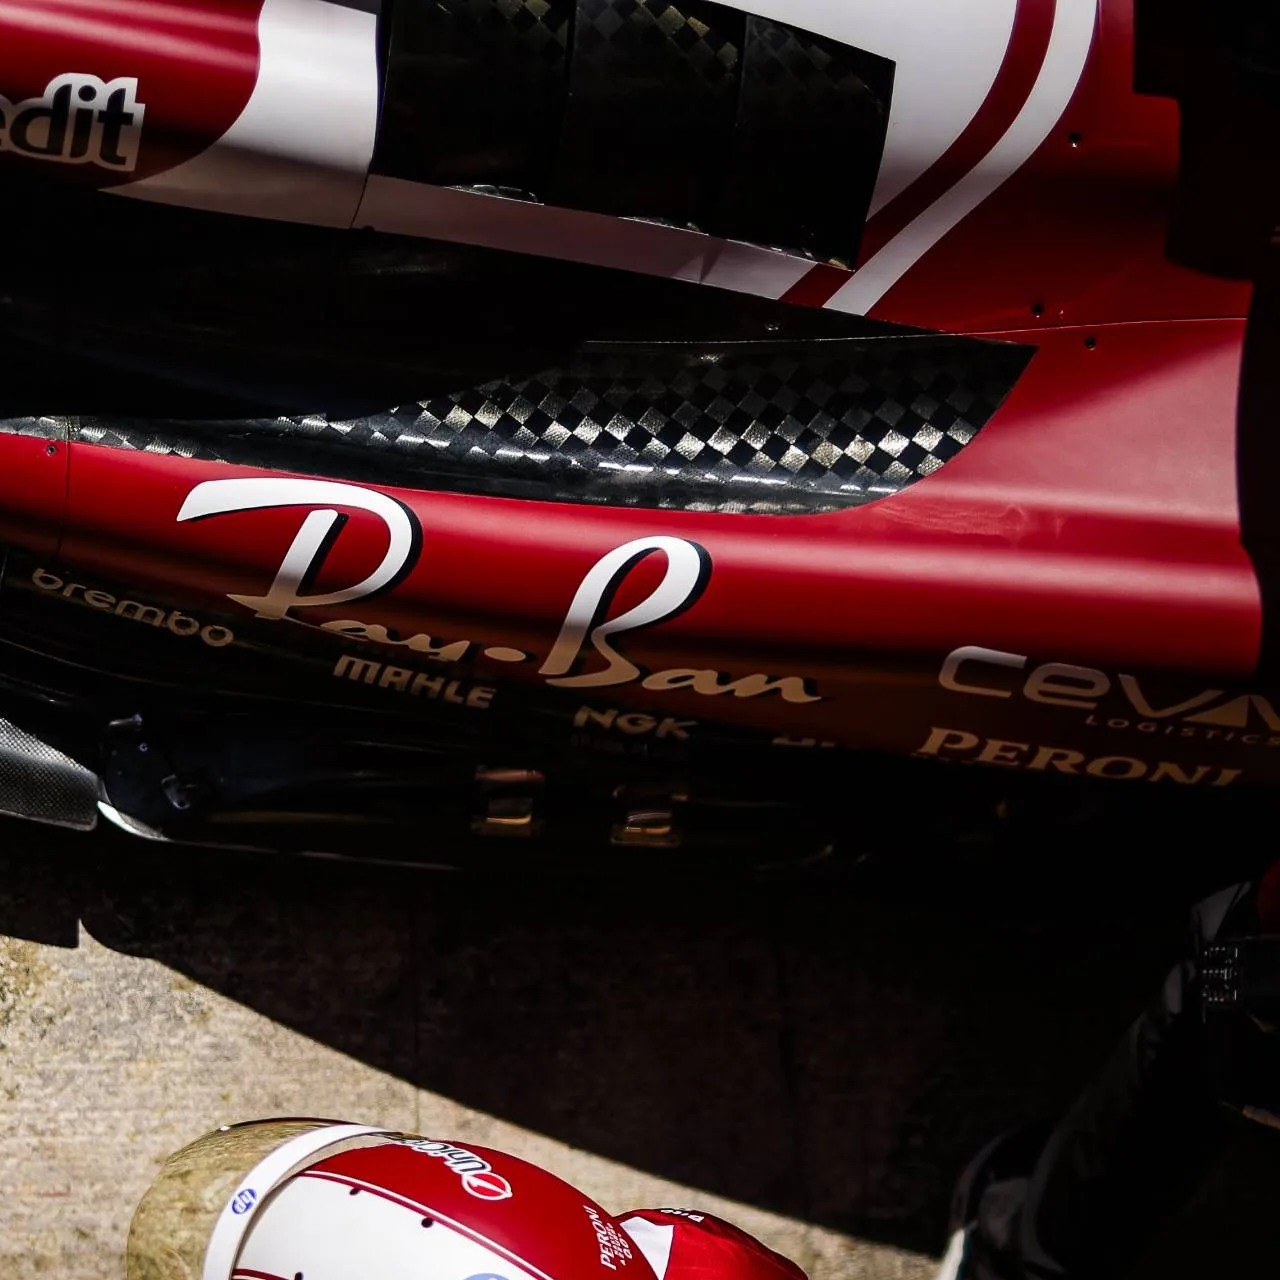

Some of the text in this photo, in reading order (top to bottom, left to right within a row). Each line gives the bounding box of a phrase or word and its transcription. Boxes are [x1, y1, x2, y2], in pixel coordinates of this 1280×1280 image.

[30, 567, 236, 648] brembo
[176, 477, 823, 704] Ray-Ban
[333, 654, 499, 709] MAHLE
[571, 704, 699, 742] NGK
[911, 725, 1244, 788] PERONI
[582, 1204, 617, 1271] PERONI
